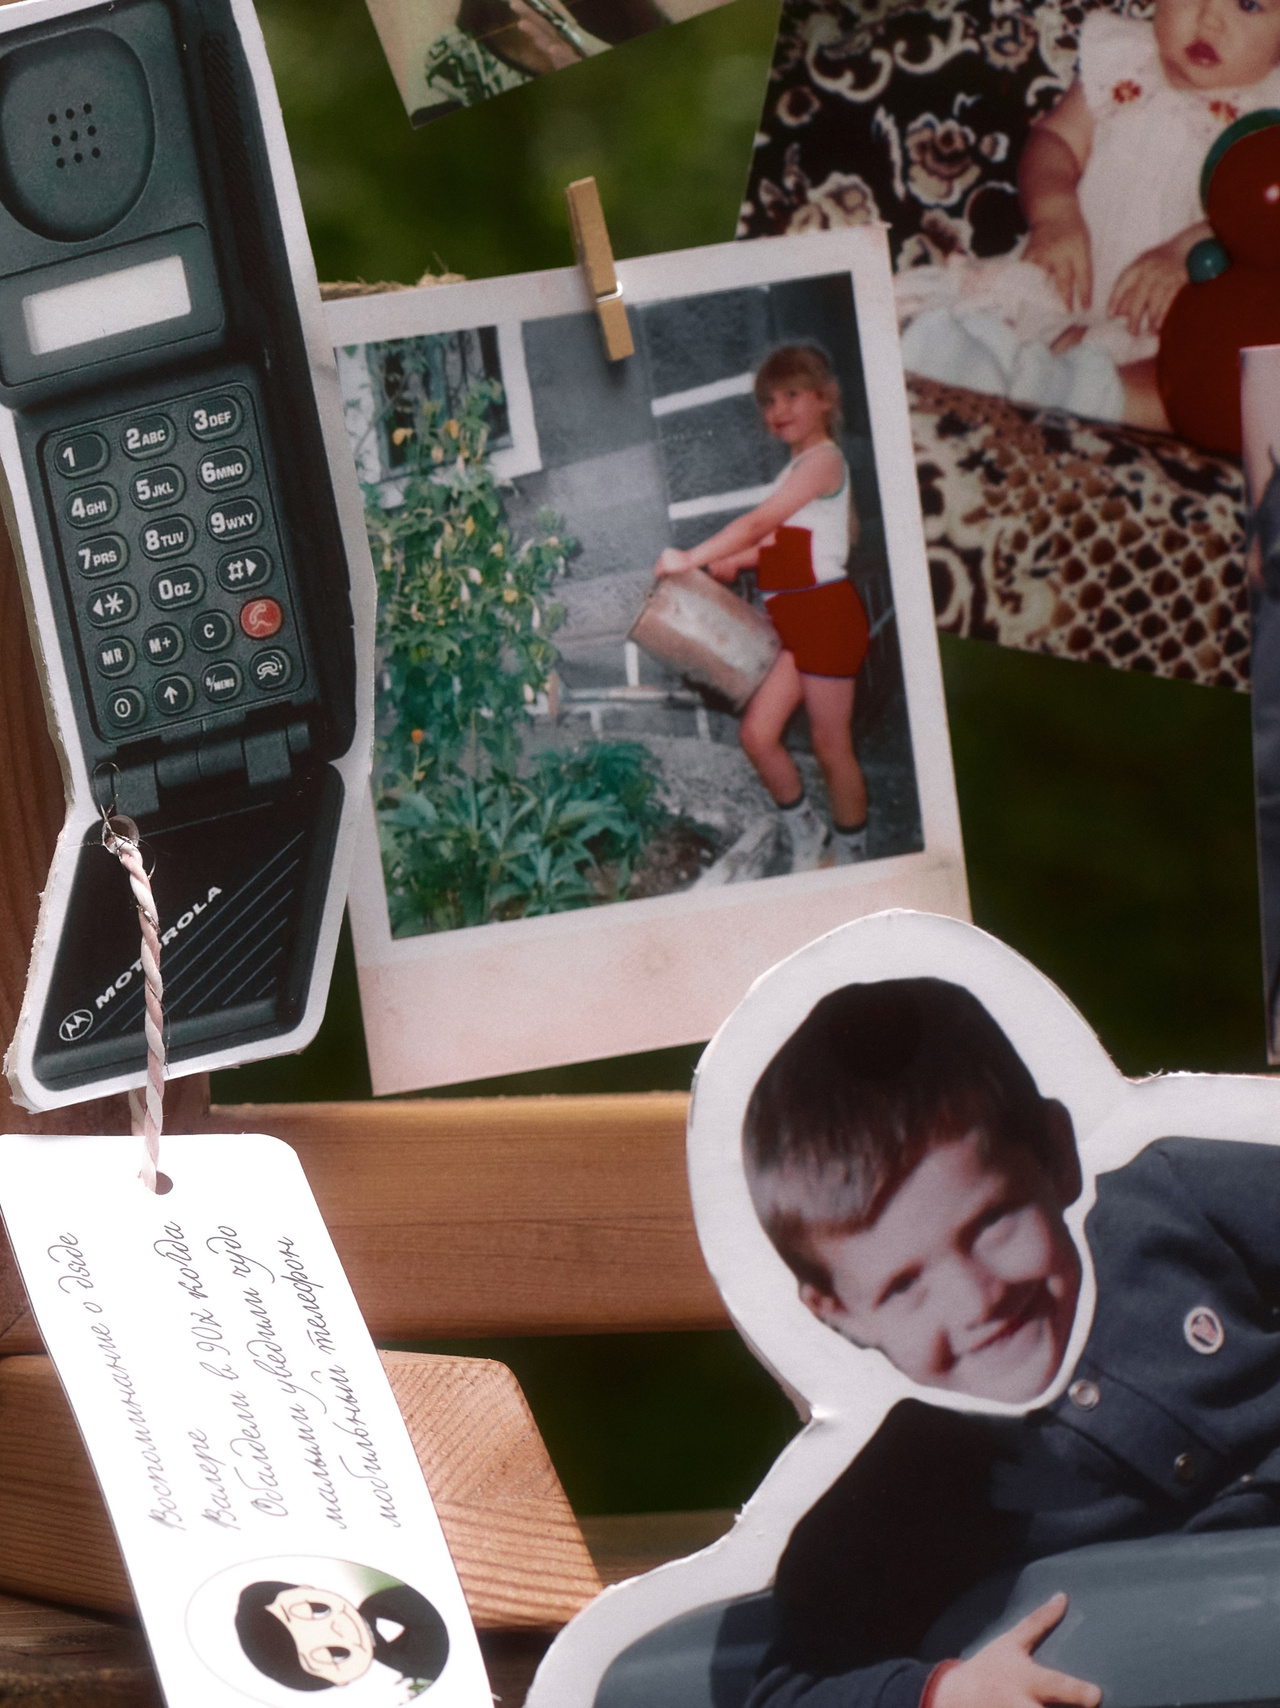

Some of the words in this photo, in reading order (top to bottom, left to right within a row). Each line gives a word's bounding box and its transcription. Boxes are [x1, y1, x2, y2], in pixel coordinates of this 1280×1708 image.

[62, 446, 76, 468] 1
[101, 647, 123, 666] MR
[203, 623, 215, 639] C
[94, 886, 223, 1010] MOTROLA
[46, 1231, 95, 1294] дяде
[152, 1220, 209, 1301] когда
[206, 1224, 276, 1284] чудо
[82, 1300, 103, 1314] о
[277, 1236, 337, 1355] телефон
[200, 1362, 240, 1382] в
[91, 1321, 187, 1532] Воспоминание
[229, 1390, 289, 1518] Обалдели
[311, 1363, 403, 1529] мобильный
[187, 1428, 242, 1531] Валере
